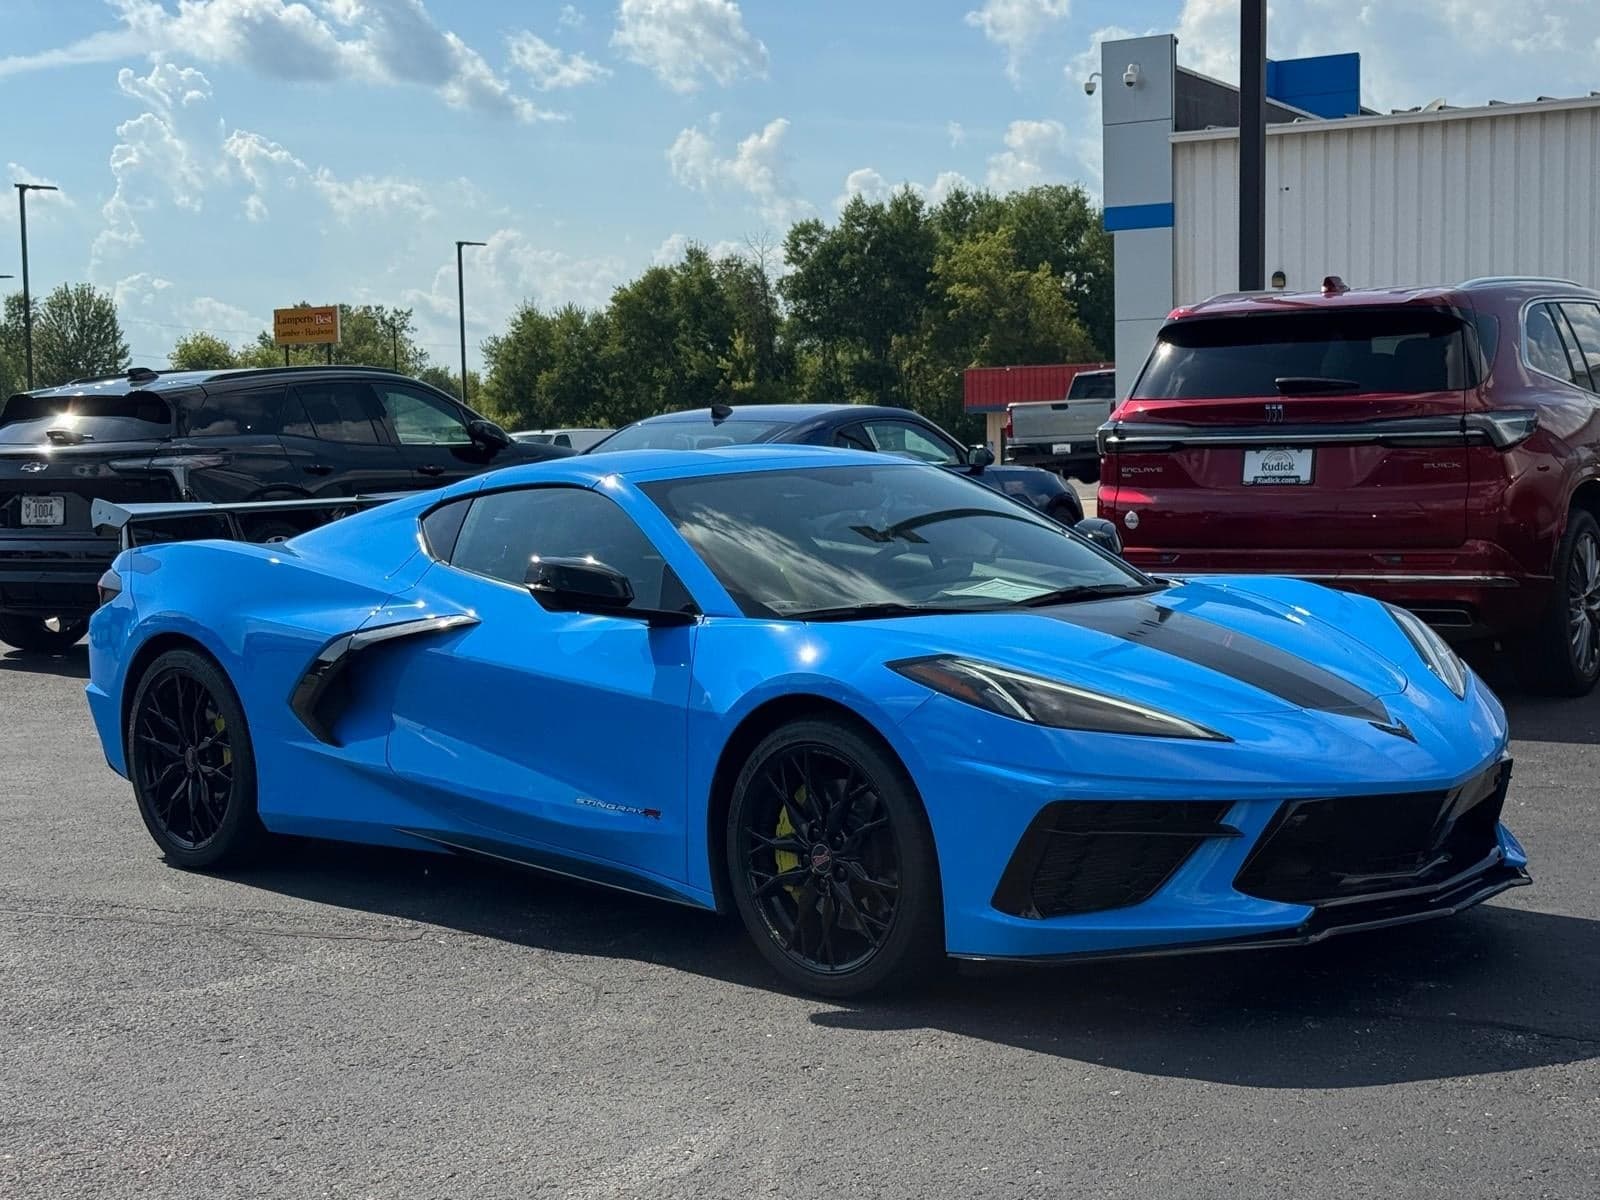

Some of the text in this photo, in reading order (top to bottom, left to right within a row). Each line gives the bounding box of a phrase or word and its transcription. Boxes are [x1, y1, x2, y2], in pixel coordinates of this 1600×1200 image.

[1261, 461, 1295, 472] Kudick
[34, 503, 54, 519] 1004
[576, 798, 643, 815] STINGRAY
